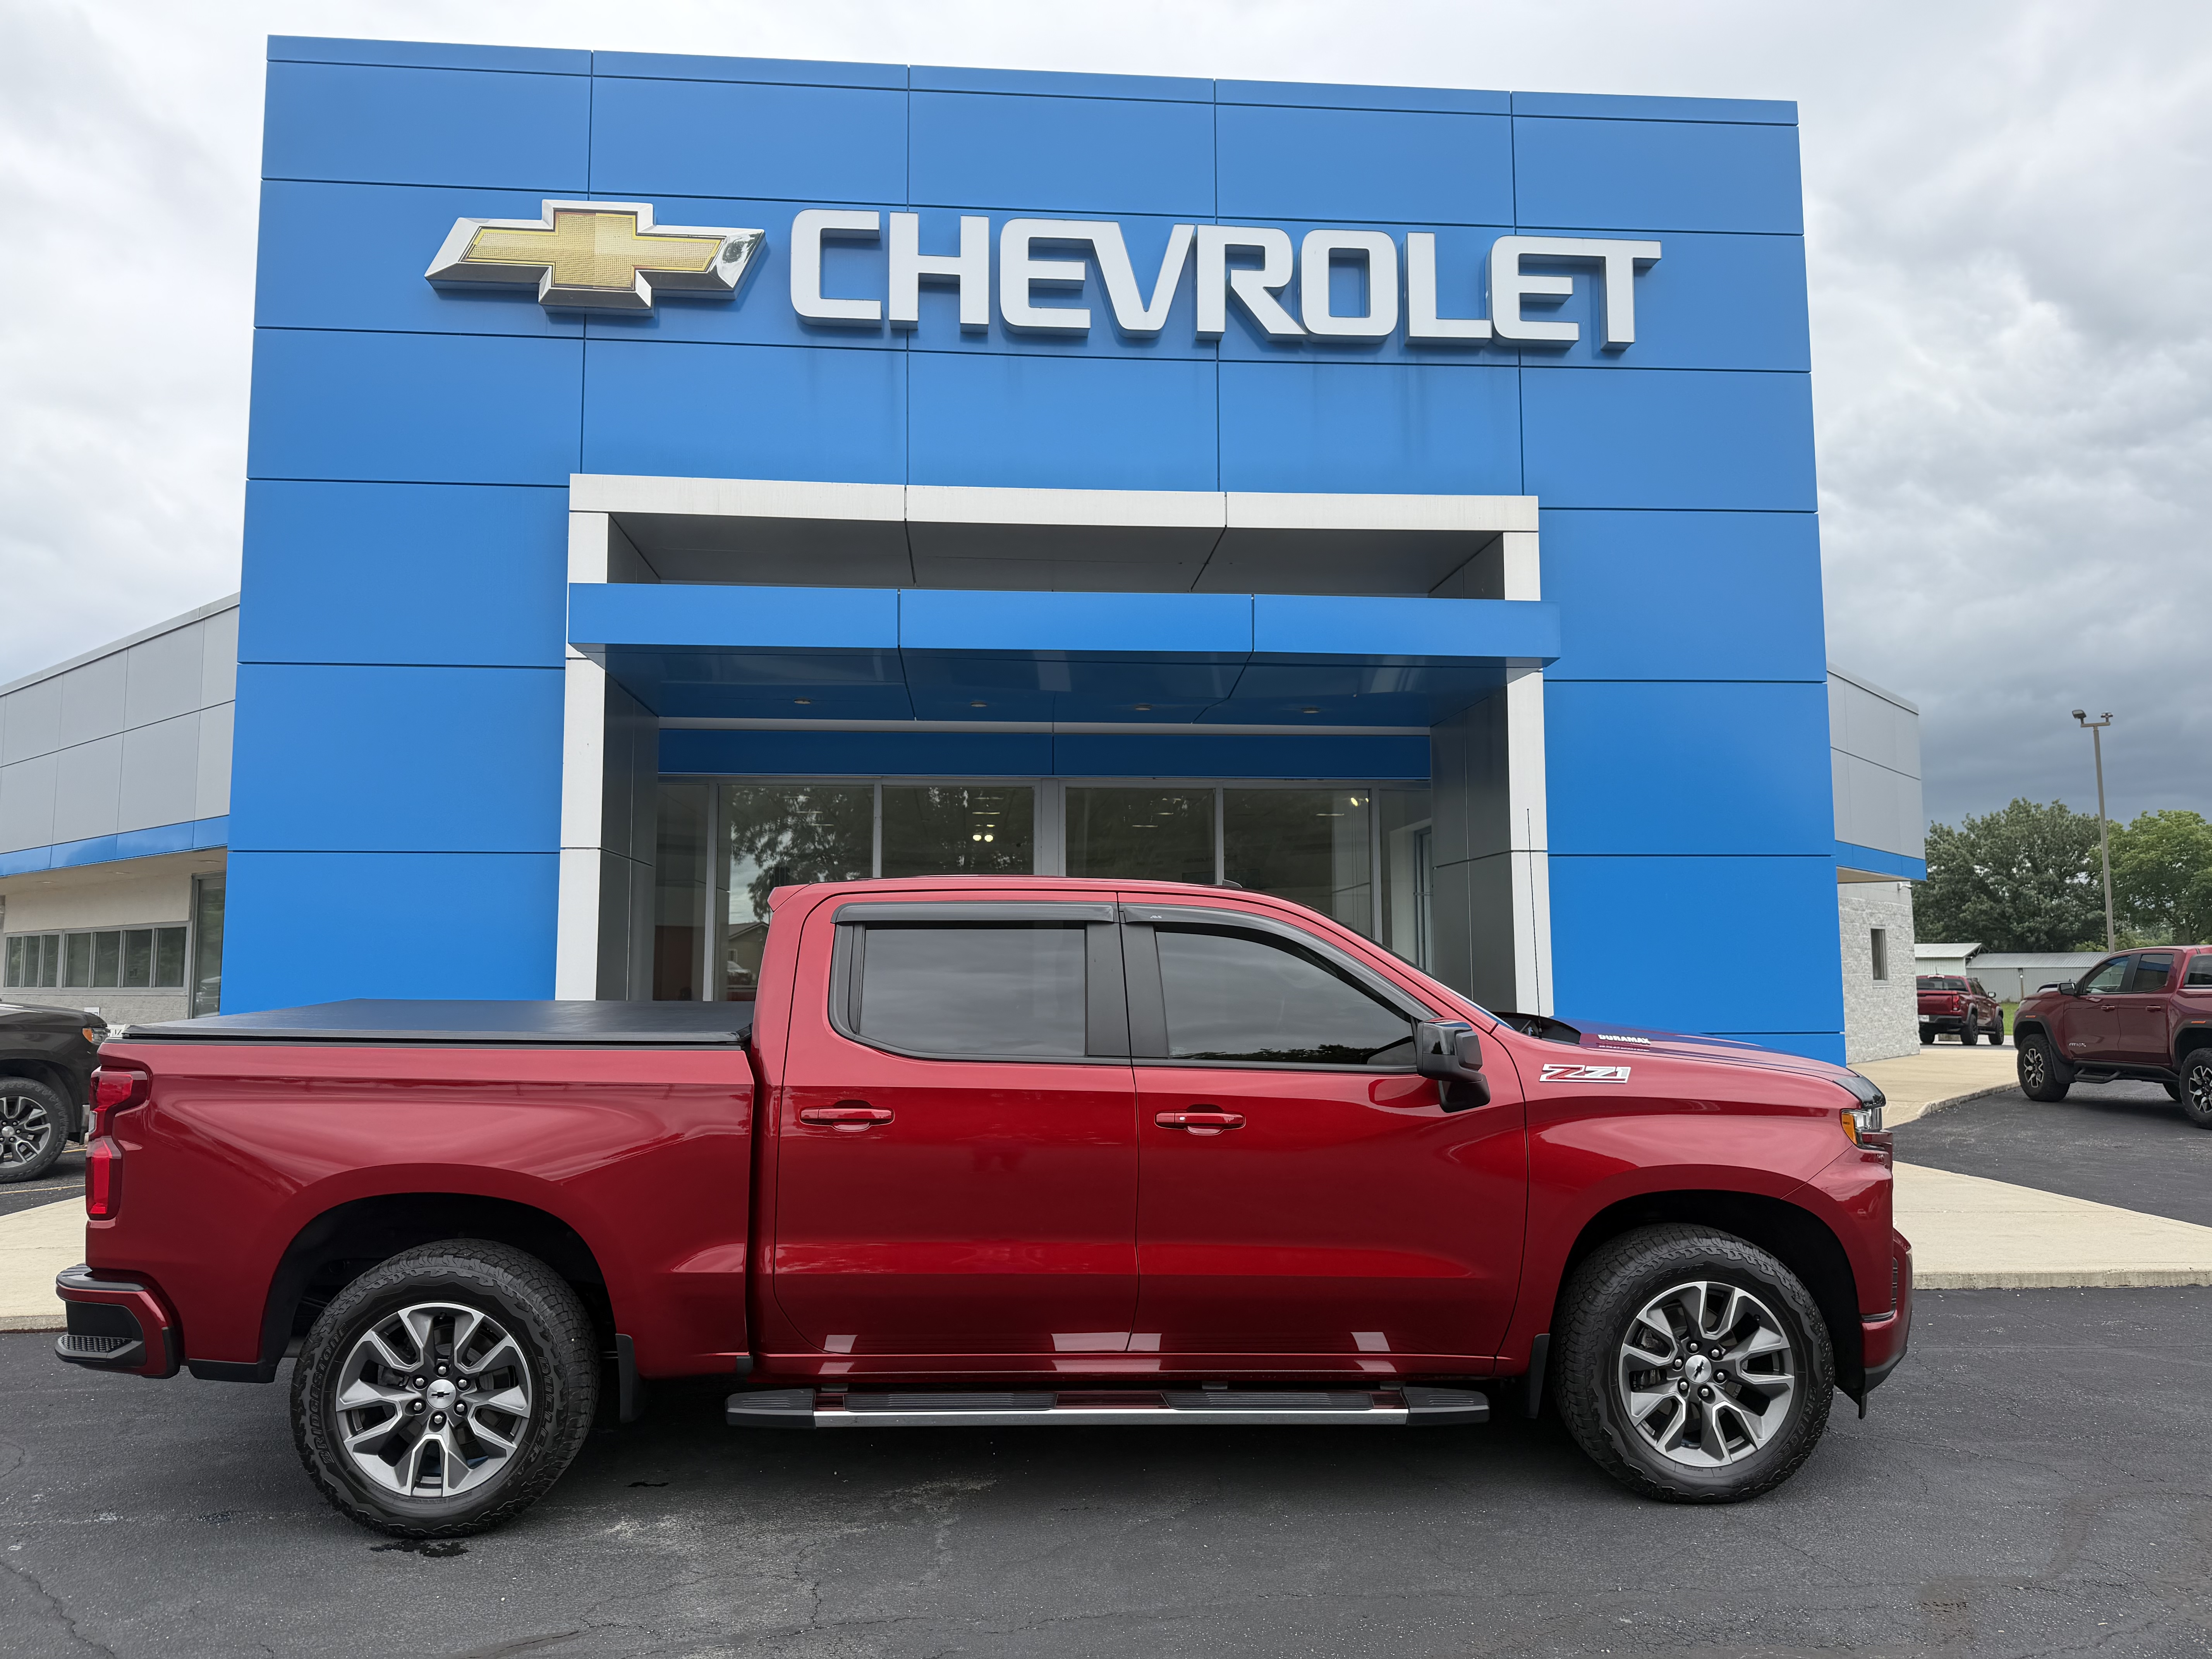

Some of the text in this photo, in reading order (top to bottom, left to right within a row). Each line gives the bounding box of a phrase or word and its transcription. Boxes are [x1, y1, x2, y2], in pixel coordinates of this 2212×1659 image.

[790, 208, 1662, 351] CHEVROLET
[1539, 1063, 1631, 1083] Z71
[1598, 1034, 1651, 1044] DURAMAX
[309, 1322, 349, 1464] BRIDGESTONE
